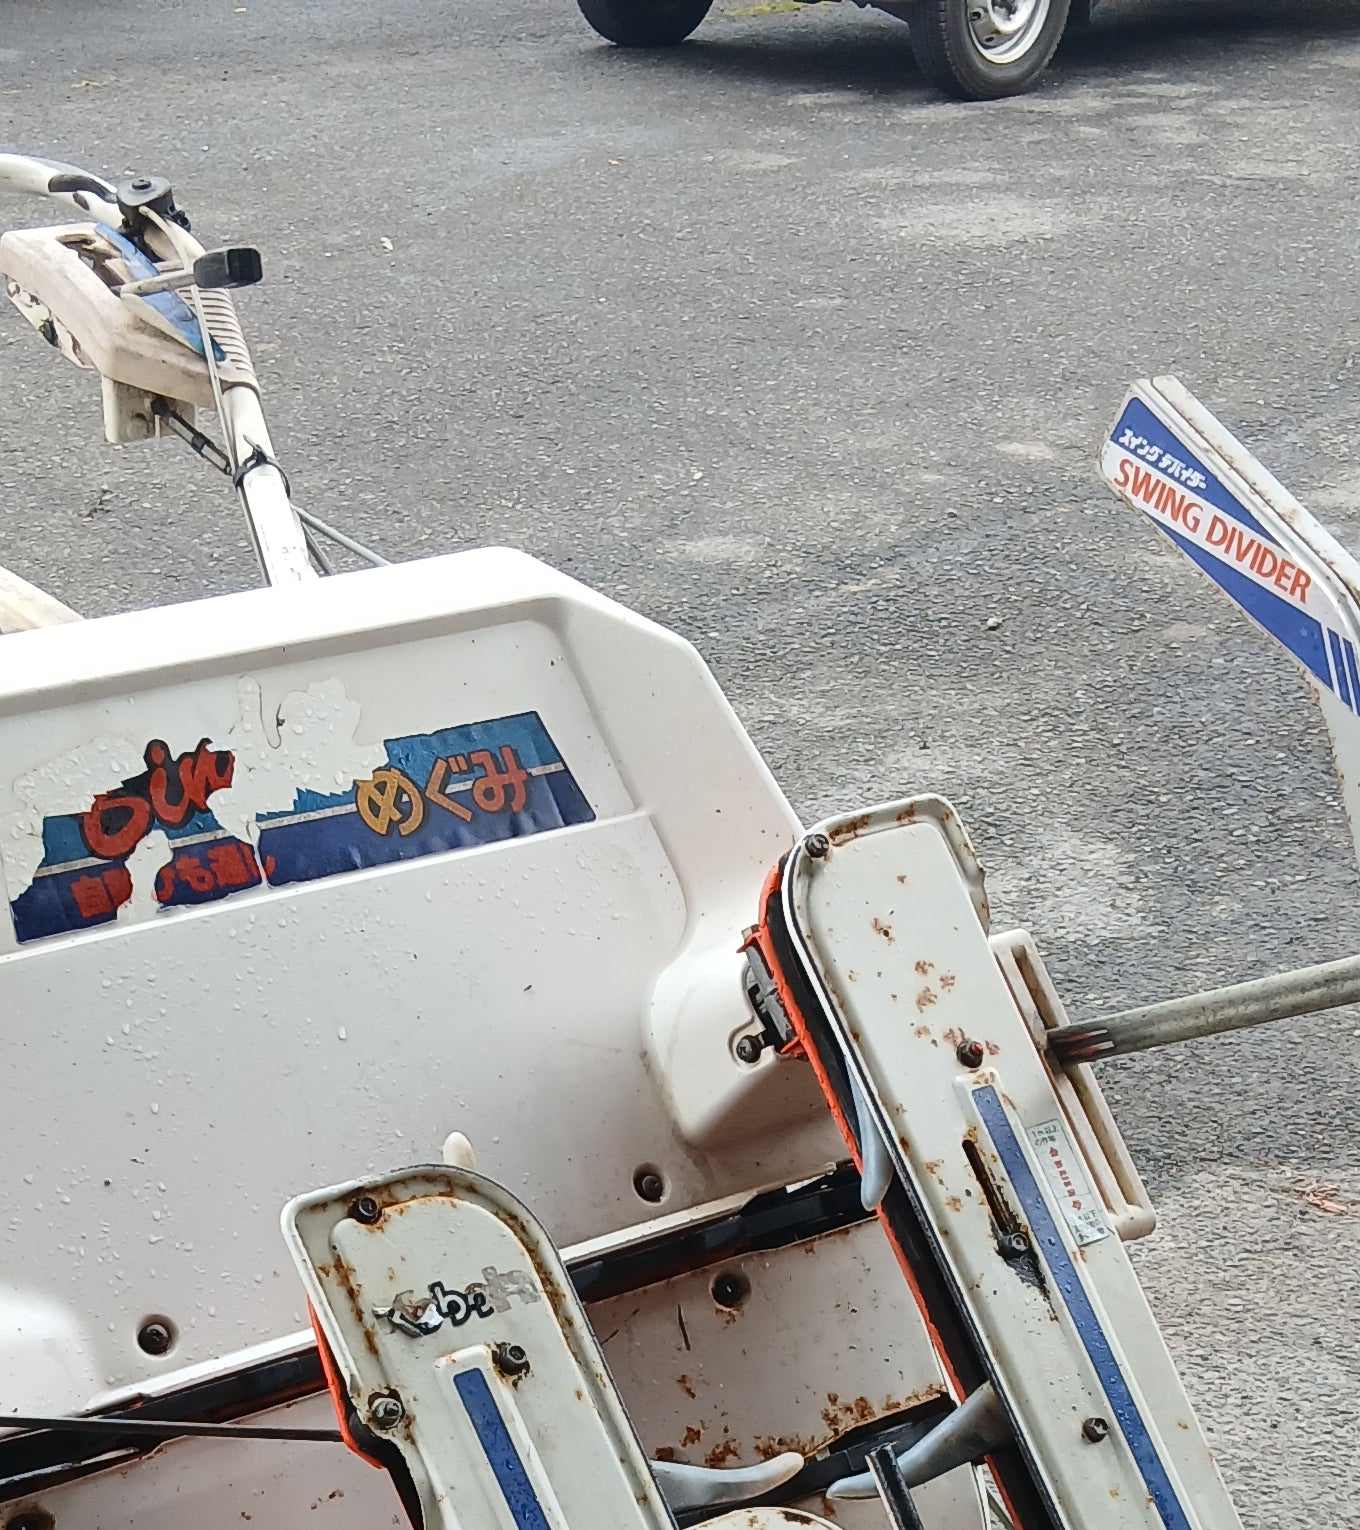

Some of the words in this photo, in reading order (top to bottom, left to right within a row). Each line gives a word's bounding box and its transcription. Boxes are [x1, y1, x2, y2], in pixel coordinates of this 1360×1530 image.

[1118, 427, 1160, 461] スイング
[1157, 450, 1208, 489] デバイダー
[1114, 458, 1204, 533] SWING
[1205, 514, 1312, 604] DIVIDER
[354, 745, 529, 837] めぐみ
